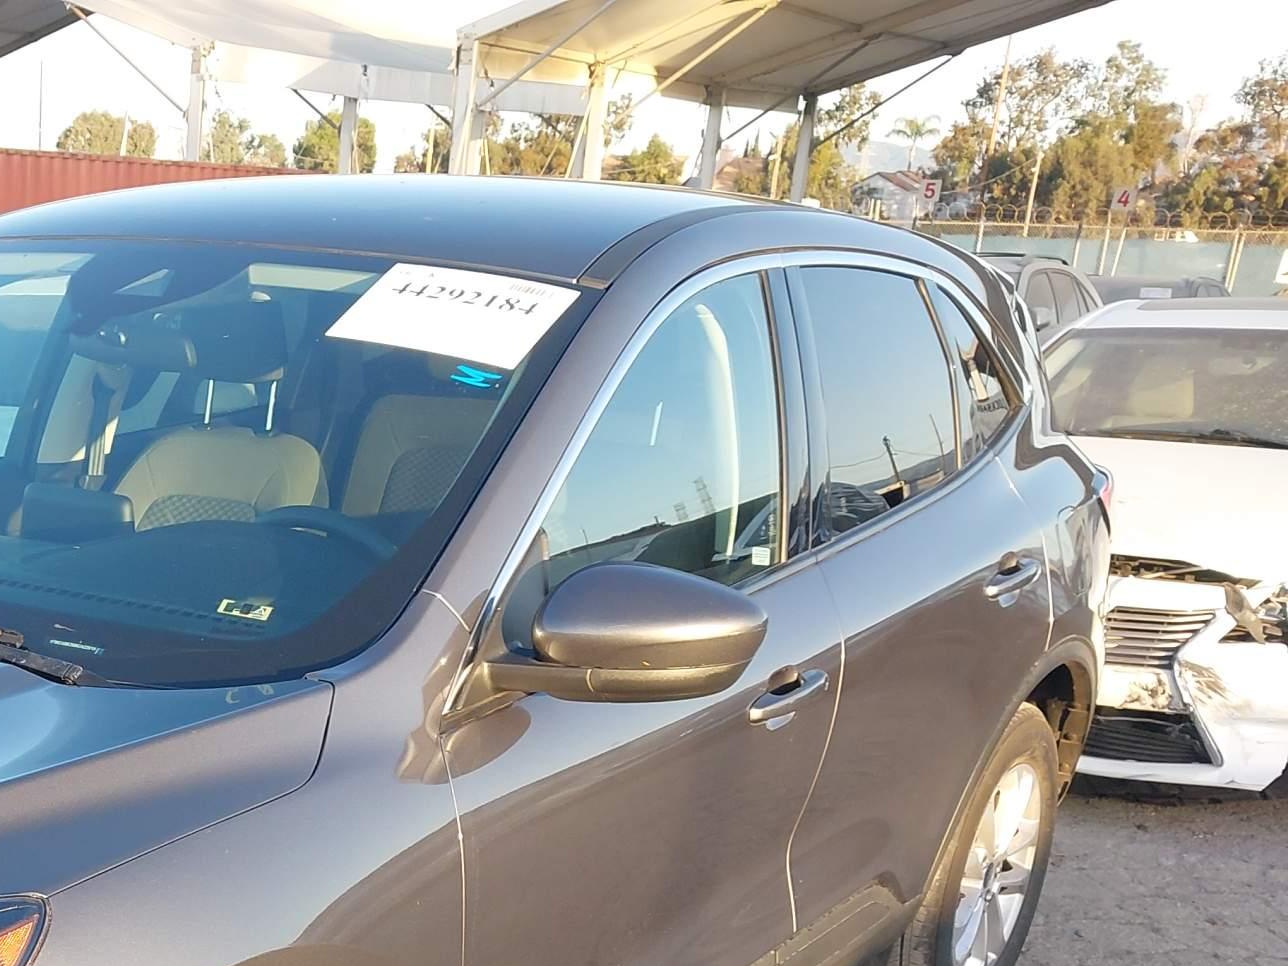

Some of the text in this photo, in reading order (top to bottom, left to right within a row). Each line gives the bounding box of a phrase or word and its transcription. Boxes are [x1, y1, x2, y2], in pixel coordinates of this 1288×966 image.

[923, 182, 936, 199] 5
[1117, 189, 1130, 207] 4
[391, 282, 539, 315] 44292184
